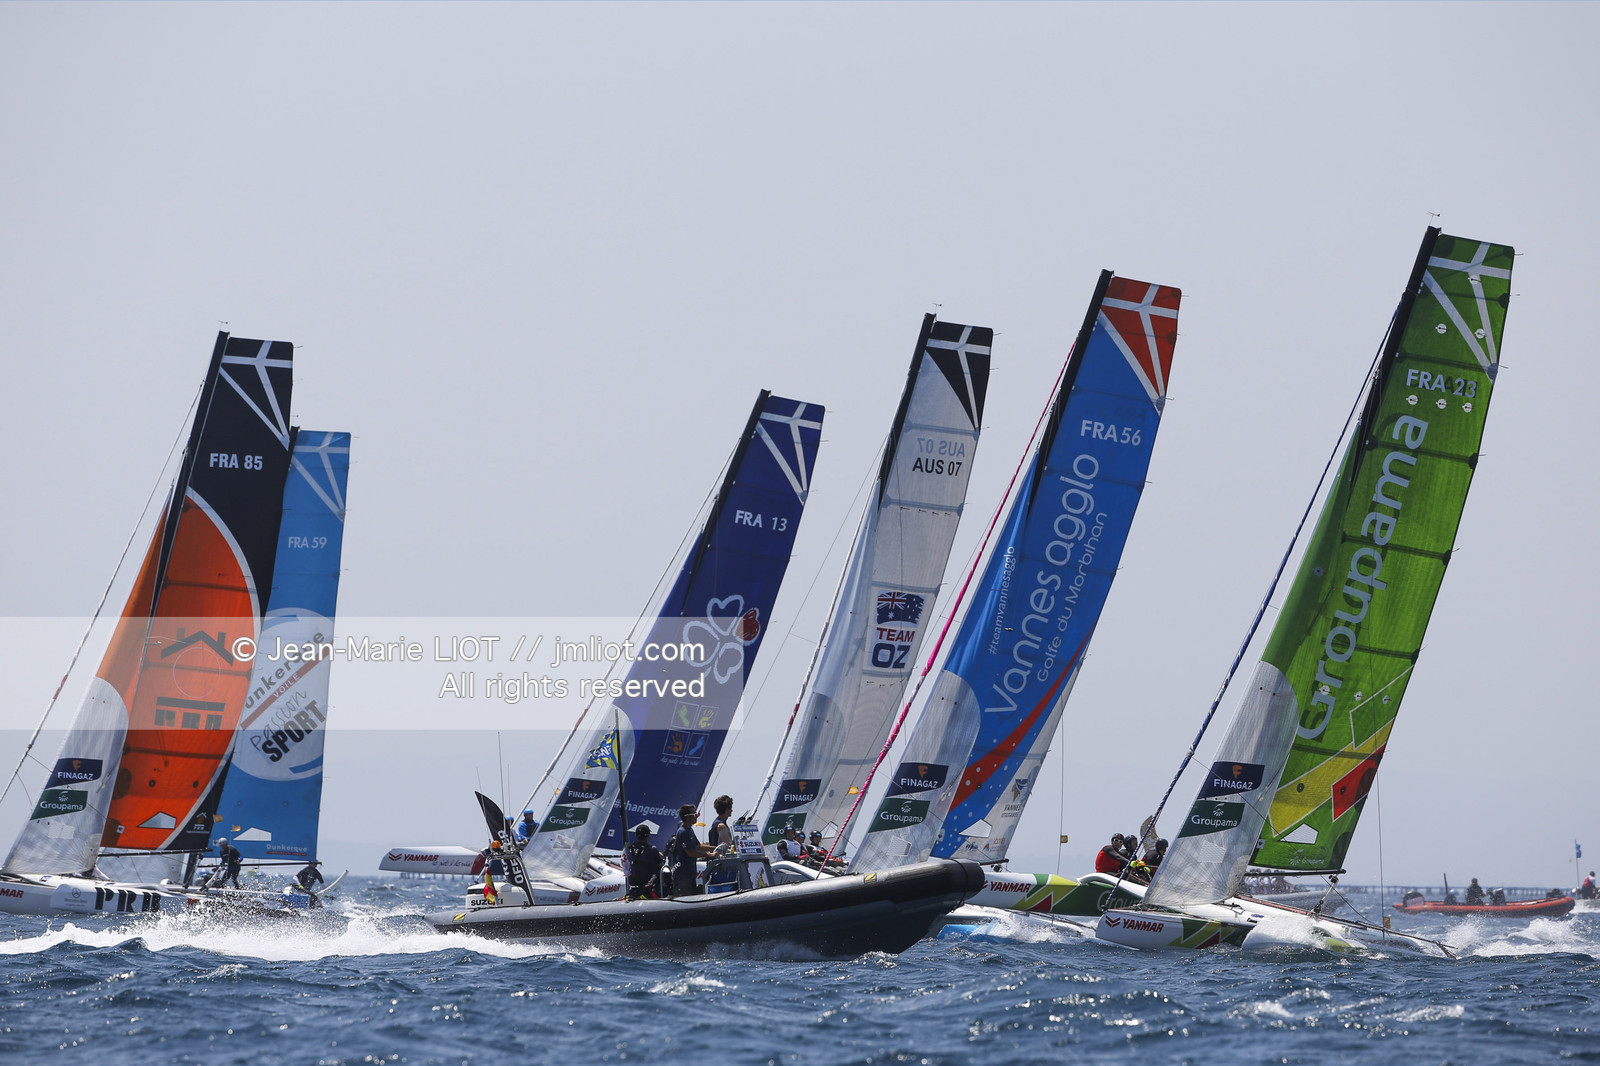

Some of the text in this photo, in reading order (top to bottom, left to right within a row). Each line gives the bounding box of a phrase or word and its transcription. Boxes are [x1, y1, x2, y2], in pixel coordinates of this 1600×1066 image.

[1406, 368, 1477, 398] FRA 23
[1080, 419, 1142, 446] FRA 56
[209, 452, 263, 471] FRA 85
[912, 457, 963, 476] AUS 07
[734, 509, 788, 532] FRA 13
[288, 536, 328, 549] FRA 59
[984, 454, 1099, 713] Vannes agglo
[1297, 414, 1430, 741] Groupama
[989, 546, 1017, 655] #teamvannesagglo
[1037, 511, 1108, 682] Golfe du Morbihan
[876, 626, 916, 643] TEAM
[871, 642, 911, 669] OZ
[273, 673, 300, 698] VOILE
[262, 700, 326, 762] SPORT
[57, 771, 94, 780] FINAGAZ
[901, 777, 939, 789] FINAGAZ
[1213, 779, 1253, 790] FINAGAZ
[567, 790, 597, 799] FINAGAZ
[784, 793, 814, 802] FINAGAZ
[40, 800, 83, 811] Groupama
[549, 815, 584, 826] Groupama
[880, 811, 923, 824] Groupama
[1191, 814, 1238, 828] Groupama
[266, 843, 308, 853] Dunkerque
[403, 853, 440, 862] YANMAR
[990, 881, 1032, 893] YANMAR
[95, 886, 161, 913] PRB
[1122, 918, 1165, 933] YANMAR
